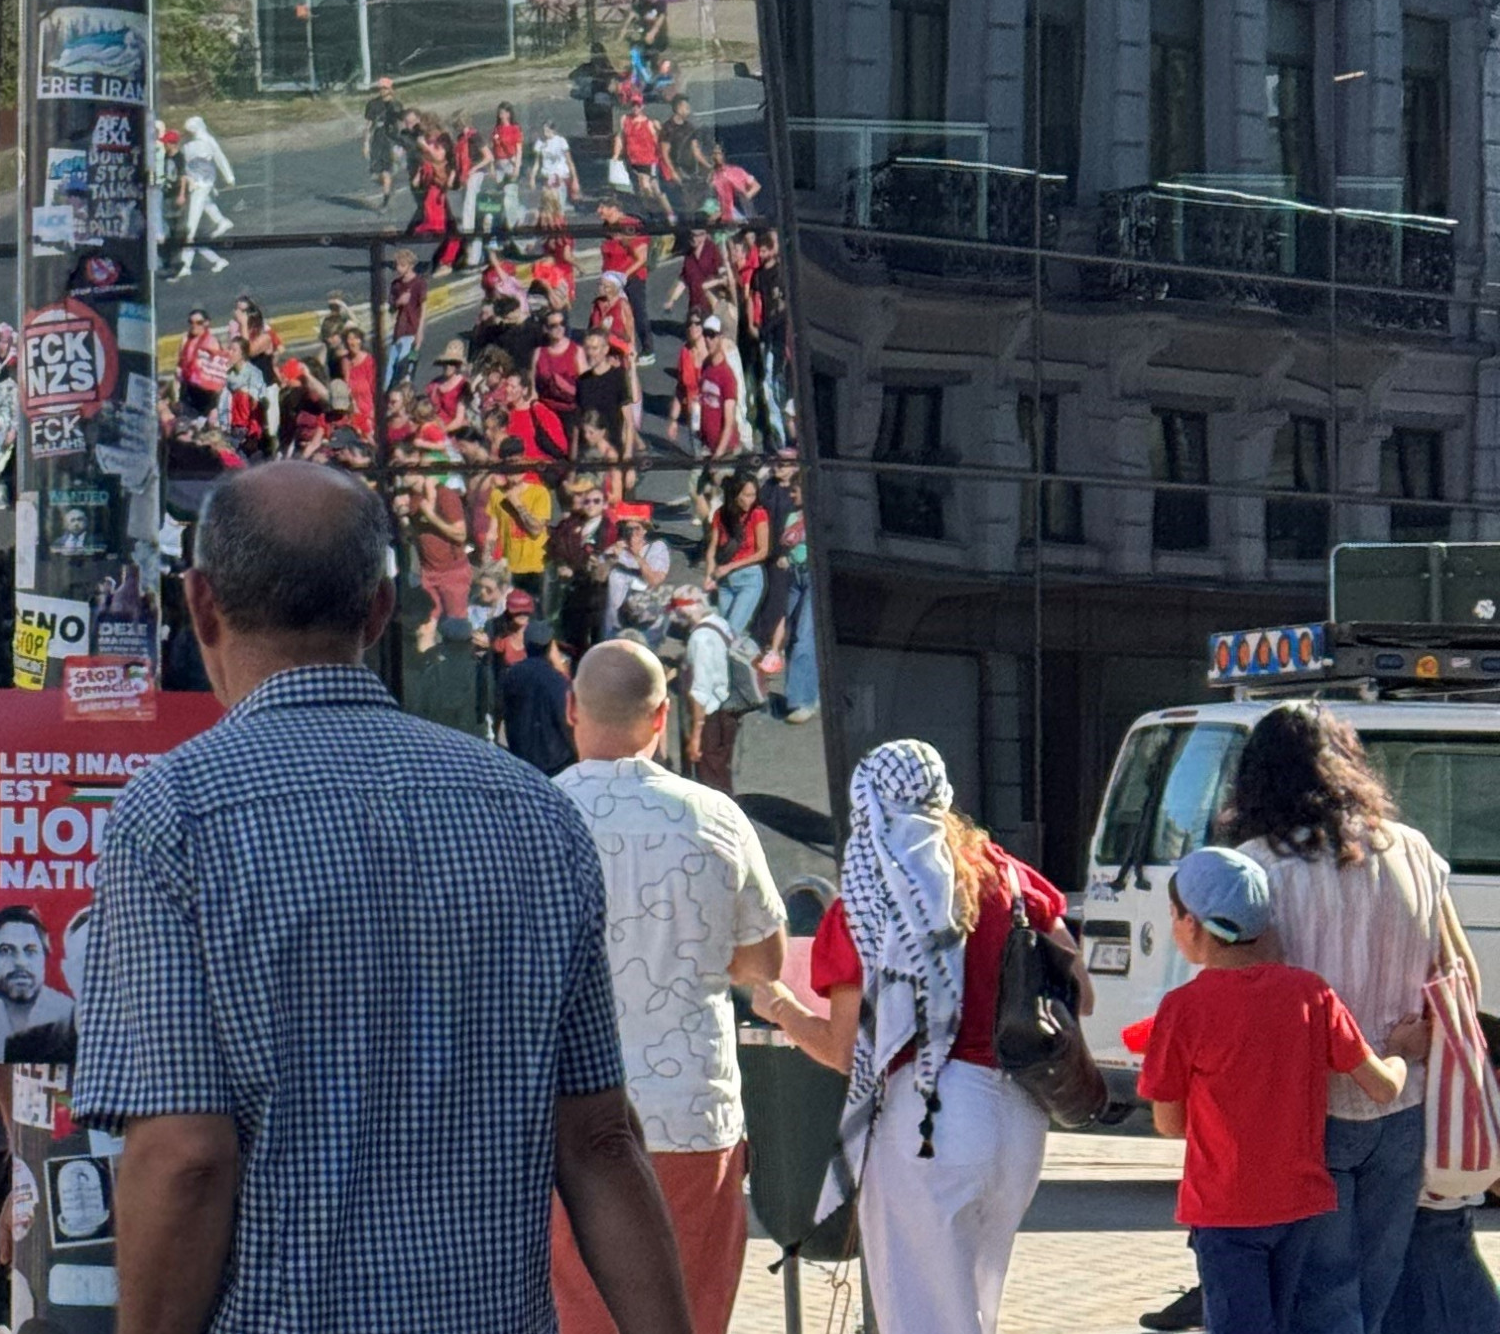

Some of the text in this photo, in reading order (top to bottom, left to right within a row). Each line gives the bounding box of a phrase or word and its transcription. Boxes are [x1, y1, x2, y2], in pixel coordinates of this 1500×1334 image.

[40, 76, 93, 95] FREE
[26, 330, 93, 366] FCK
[27, 360, 95, 398] NZS
[31, 414, 84, 443] FCK
[74, 669, 118, 685] Stop
